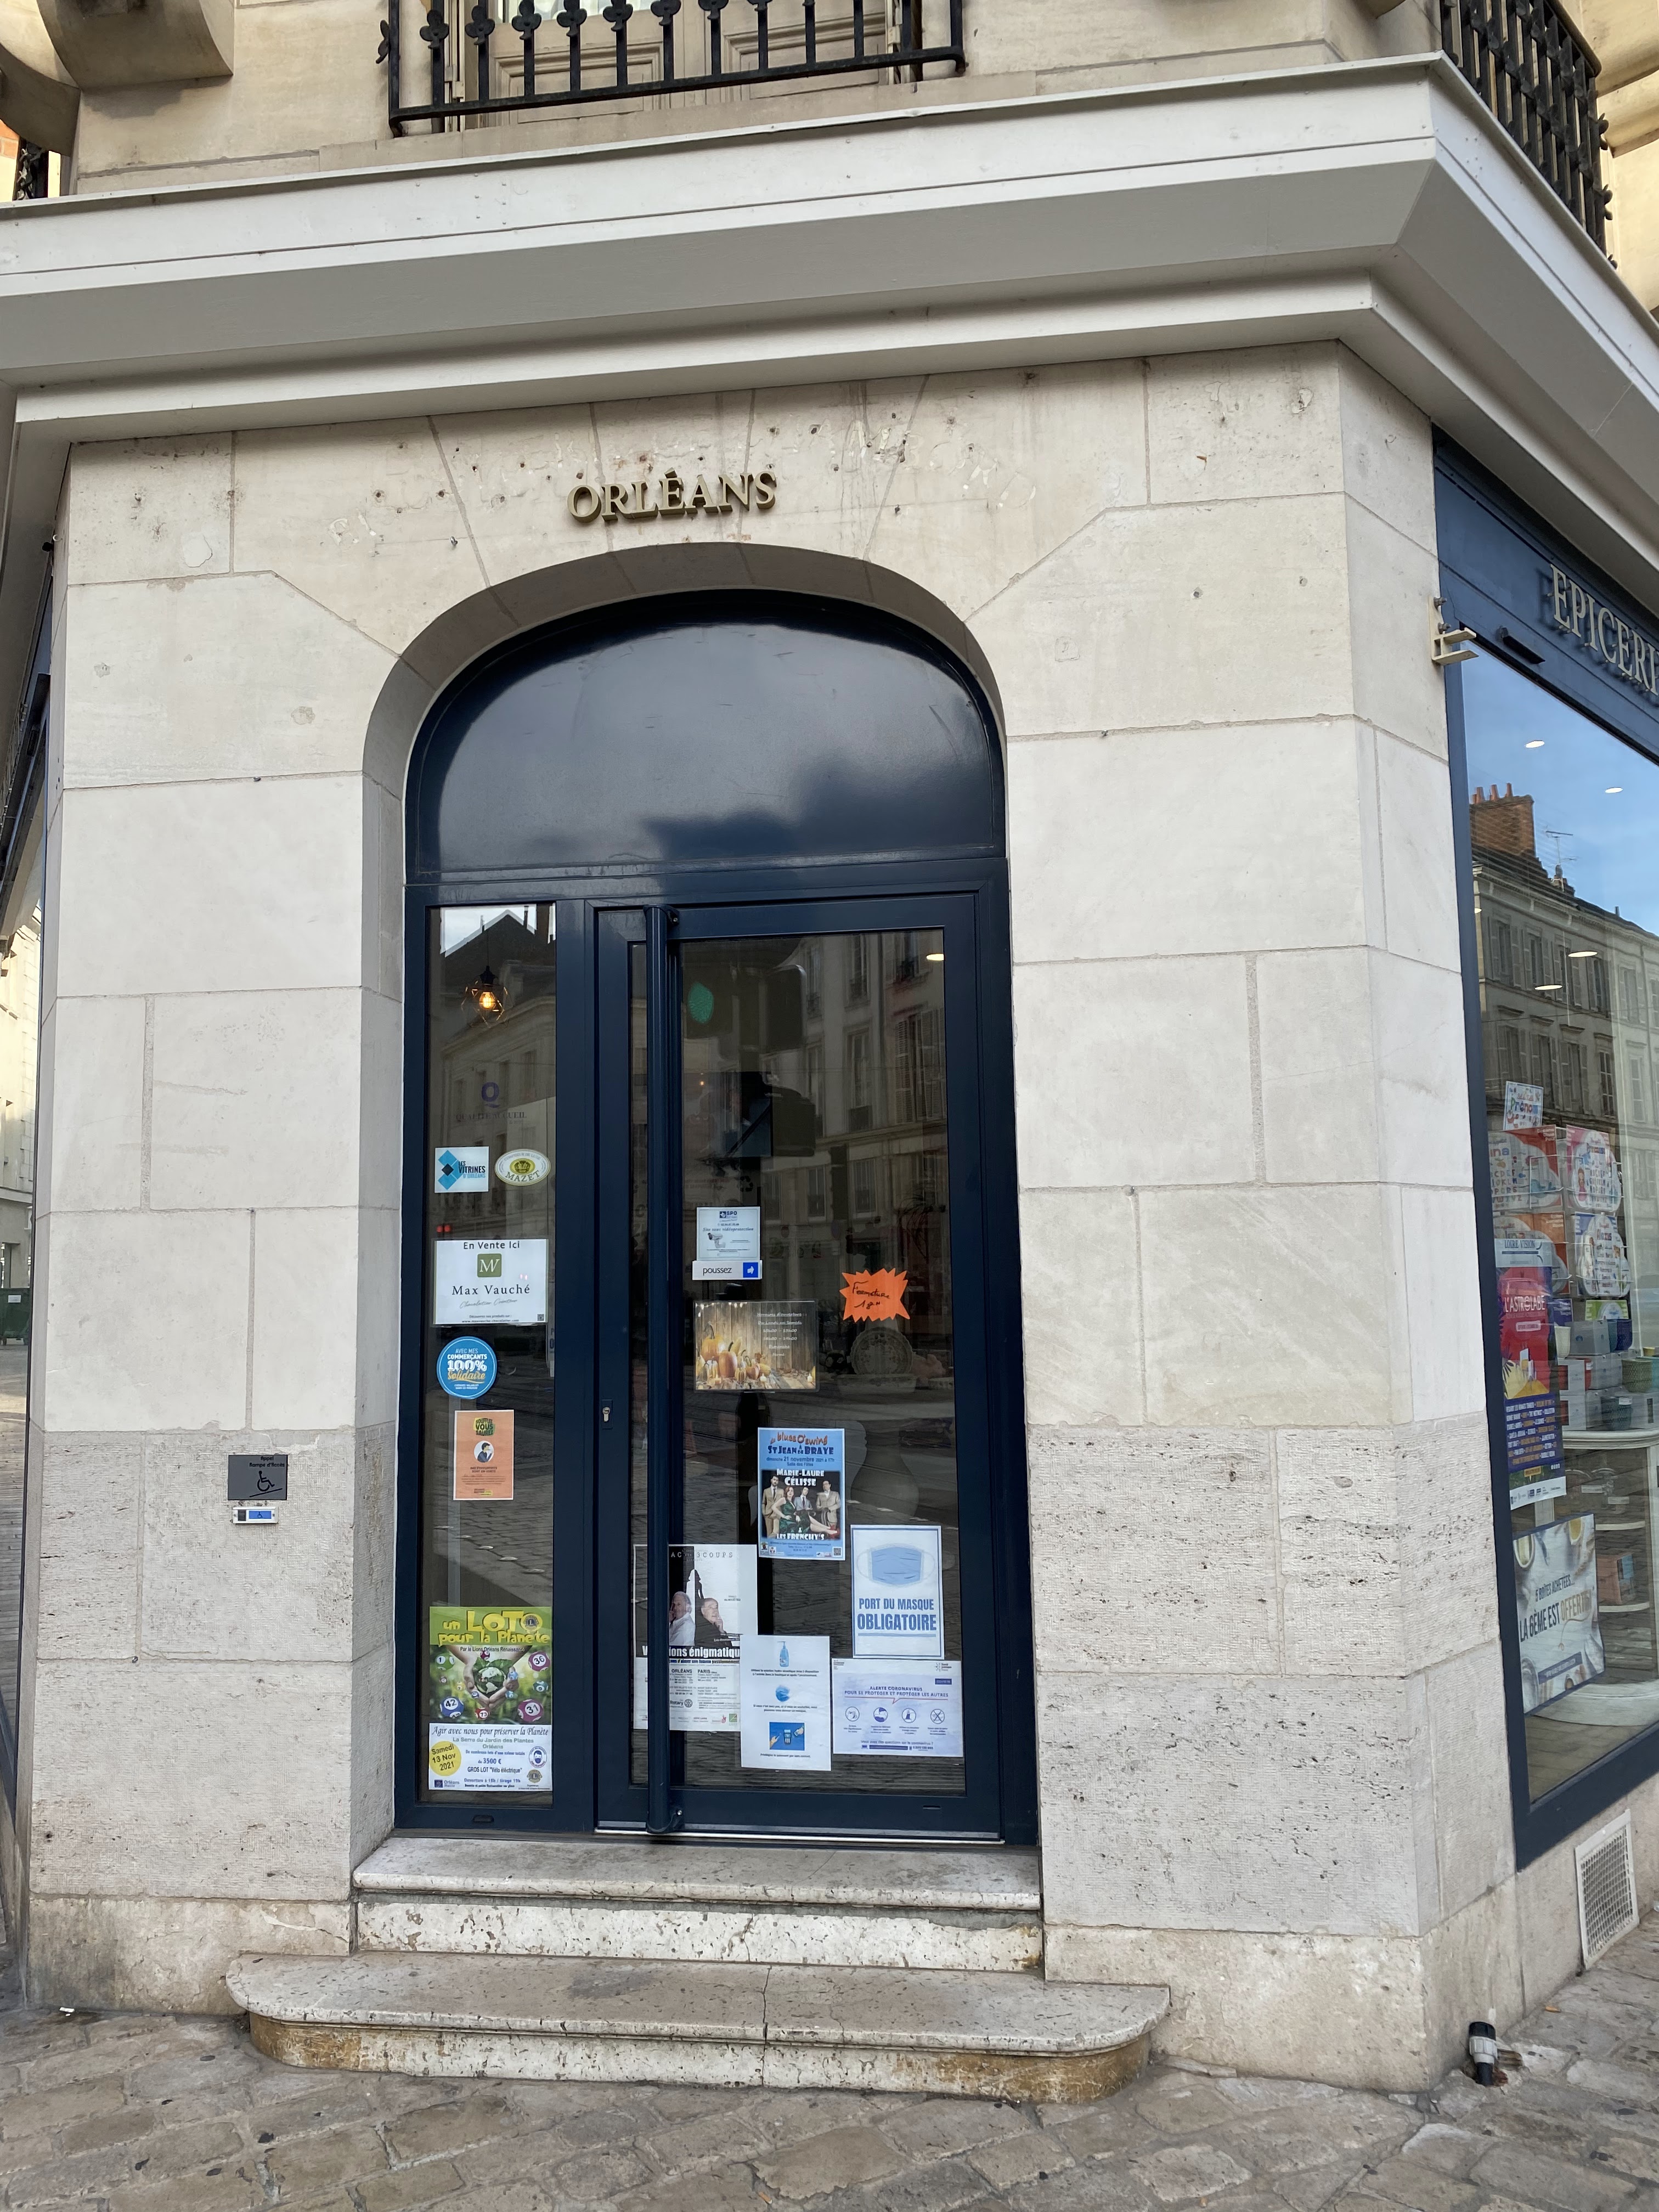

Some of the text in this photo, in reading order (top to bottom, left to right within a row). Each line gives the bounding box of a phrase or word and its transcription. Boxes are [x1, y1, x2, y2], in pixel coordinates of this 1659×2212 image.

[567, 467, 777, 523] ORLÉANS
[1550, 564, 1659, 696] EPICERI
[505, 1170, 540, 1182] MAZET
[1505, 1240, 1536, 1248] LOIRE VISION
[703, 1267, 732, 1276] poussez
[452, 1284, 530, 1295] Max Vauché
[1505, 1295, 1545, 1313] L'ASTROLABE
[447, 1360, 487, 1372] 100%
[777, 1432, 797, 1442] blues
[785, 1476, 816, 1486] CÉLISSE
[859, 1598, 934, 1611] PORT DU MASQUE
[443, 1611, 543, 1632] un LOTO
[857, 1614, 936, 1630] OBLIGATOIRE
[1520, 1618, 1528, 1642] LA
[1530, 1609, 1547, 1637] 6ÈME
[1548, 1602, 1560, 1628] EST
[438, 1628, 550, 1647] pour la Planète
[689, 1646, 740, 1658] énigmatiqu
[534, 1656, 545, 1664] 36
[527, 1705, 539, 1714] 31
[432, 1726, 447, 1736] Agir
[480, 1729, 493, 1737] pour
[494, 1728, 520, 1737] préserver
[520, 1726, 525, 1735] la
[432, 1743, 454, 1755] Samedi
[439, 1761, 454, 1771] 2021
